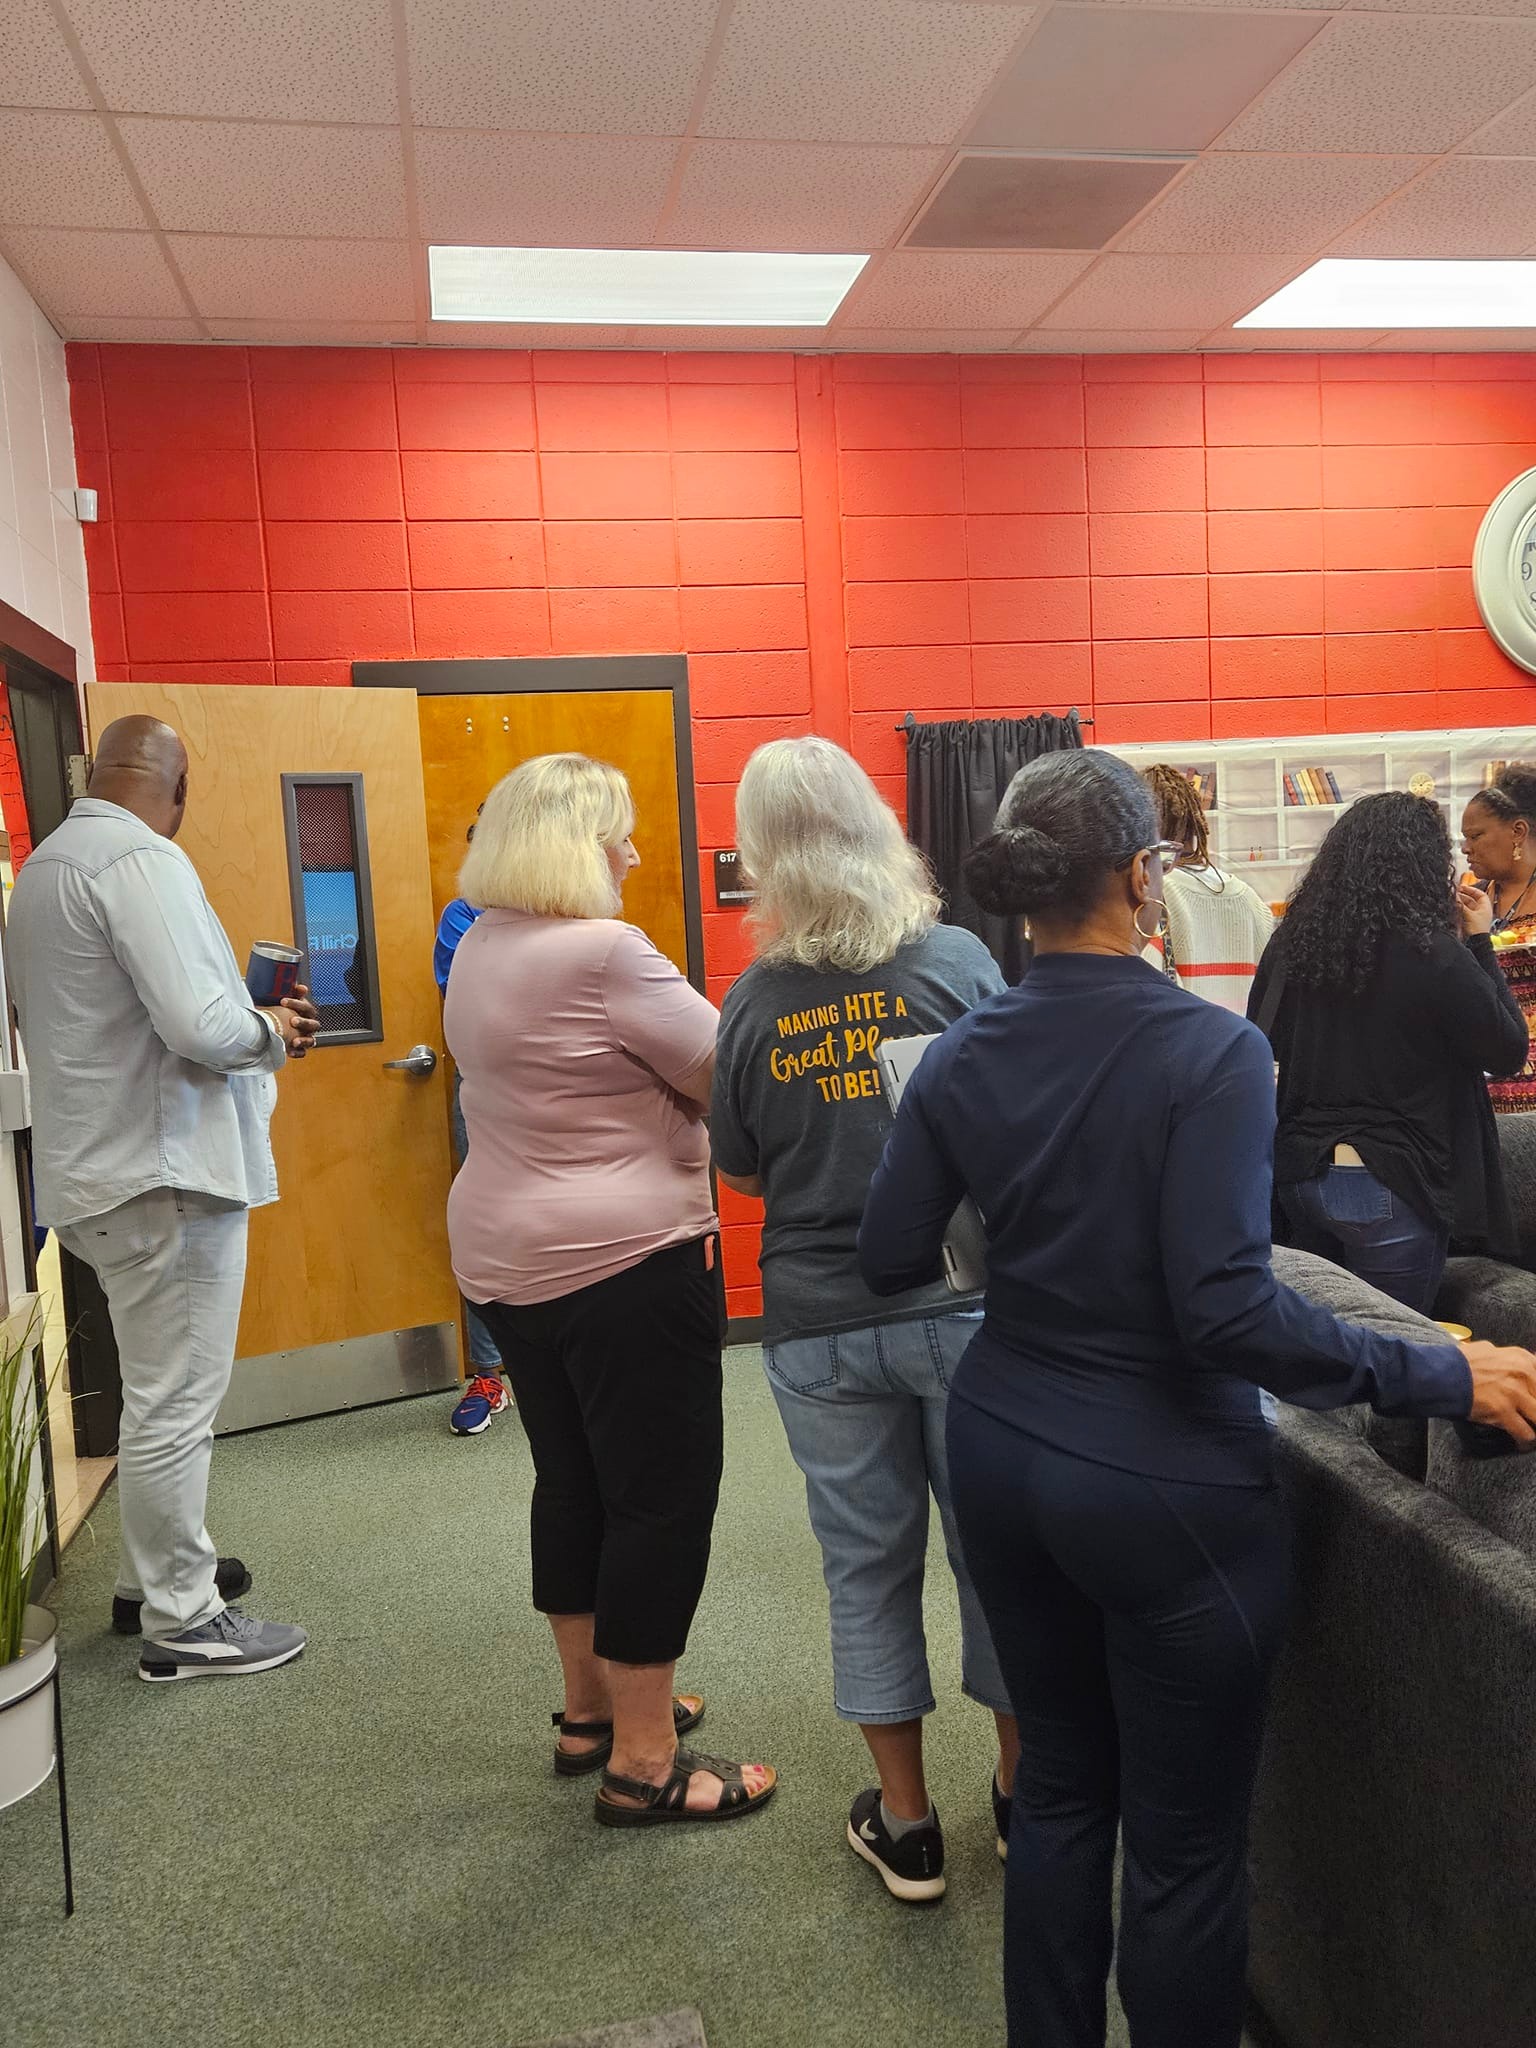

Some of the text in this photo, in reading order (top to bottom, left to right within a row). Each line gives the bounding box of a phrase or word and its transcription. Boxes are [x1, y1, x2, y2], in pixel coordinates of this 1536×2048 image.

[719, 852, 737, 863] 617
[777, 991, 908, 1039] MAKING HTE A
[770, 1031, 840, 1083] Great
[815, 1069, 881, 1103] TO BE!
